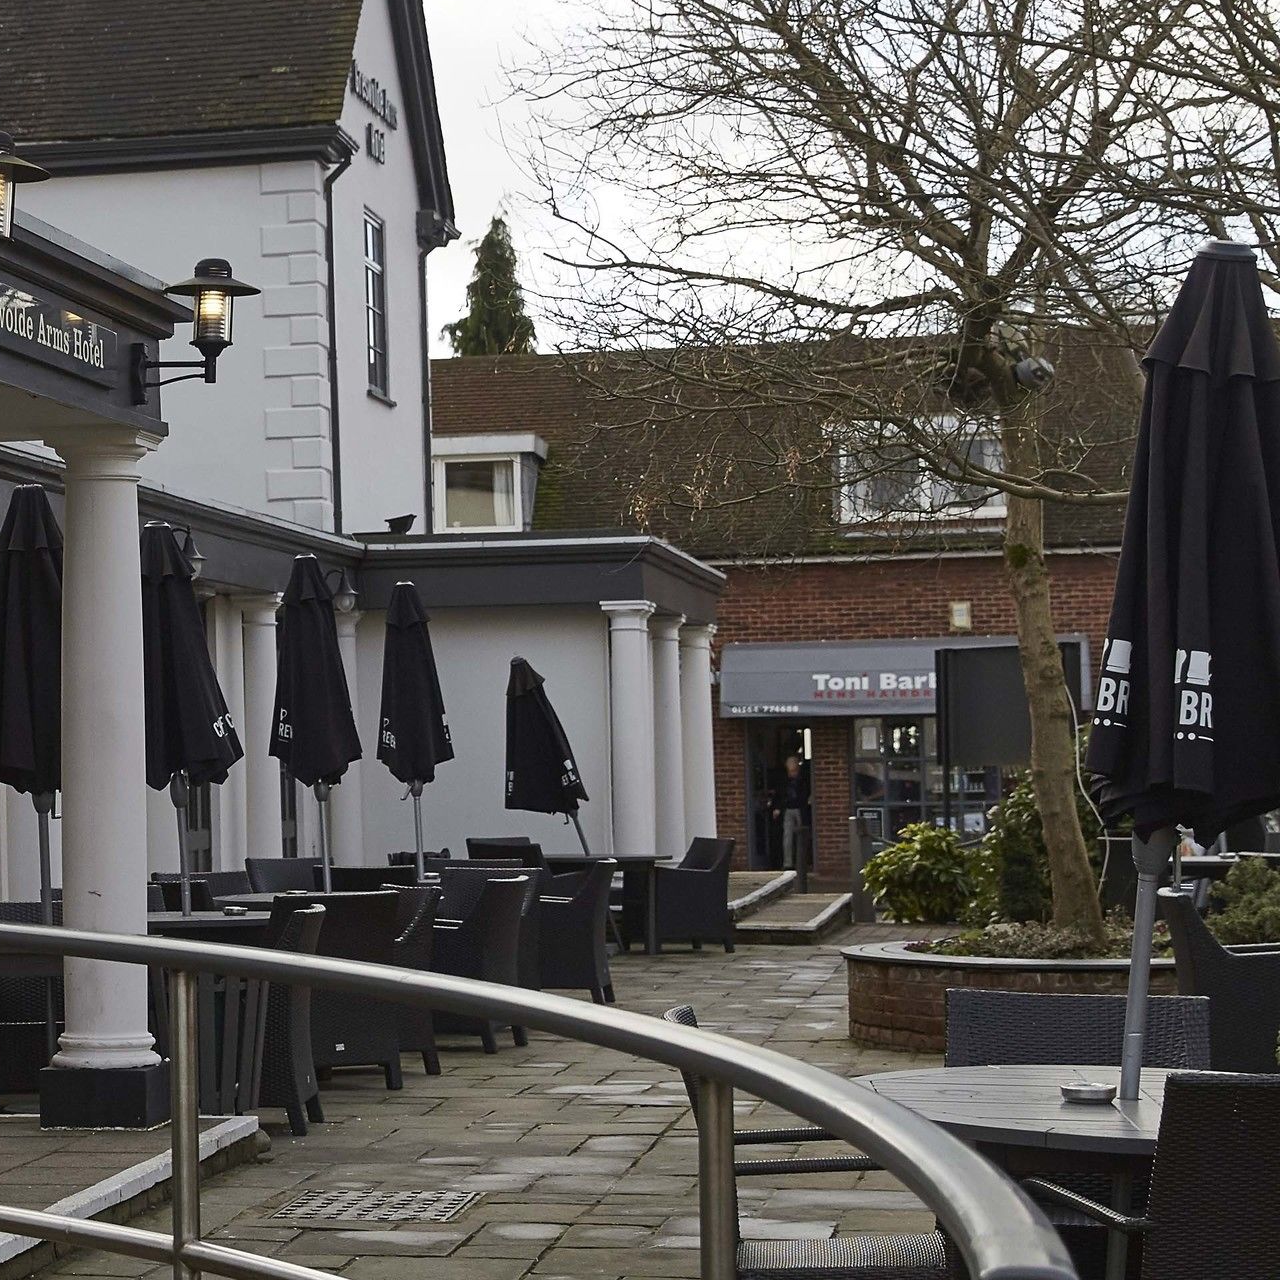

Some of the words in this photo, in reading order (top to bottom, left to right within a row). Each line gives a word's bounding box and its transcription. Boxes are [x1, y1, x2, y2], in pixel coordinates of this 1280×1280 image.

[37, 313, 70, 355] Arms
[73, 327, 105, 369] Hotel
[812, 672, 869, 691] Toni
[1179, 689, 1213, 729] BR
